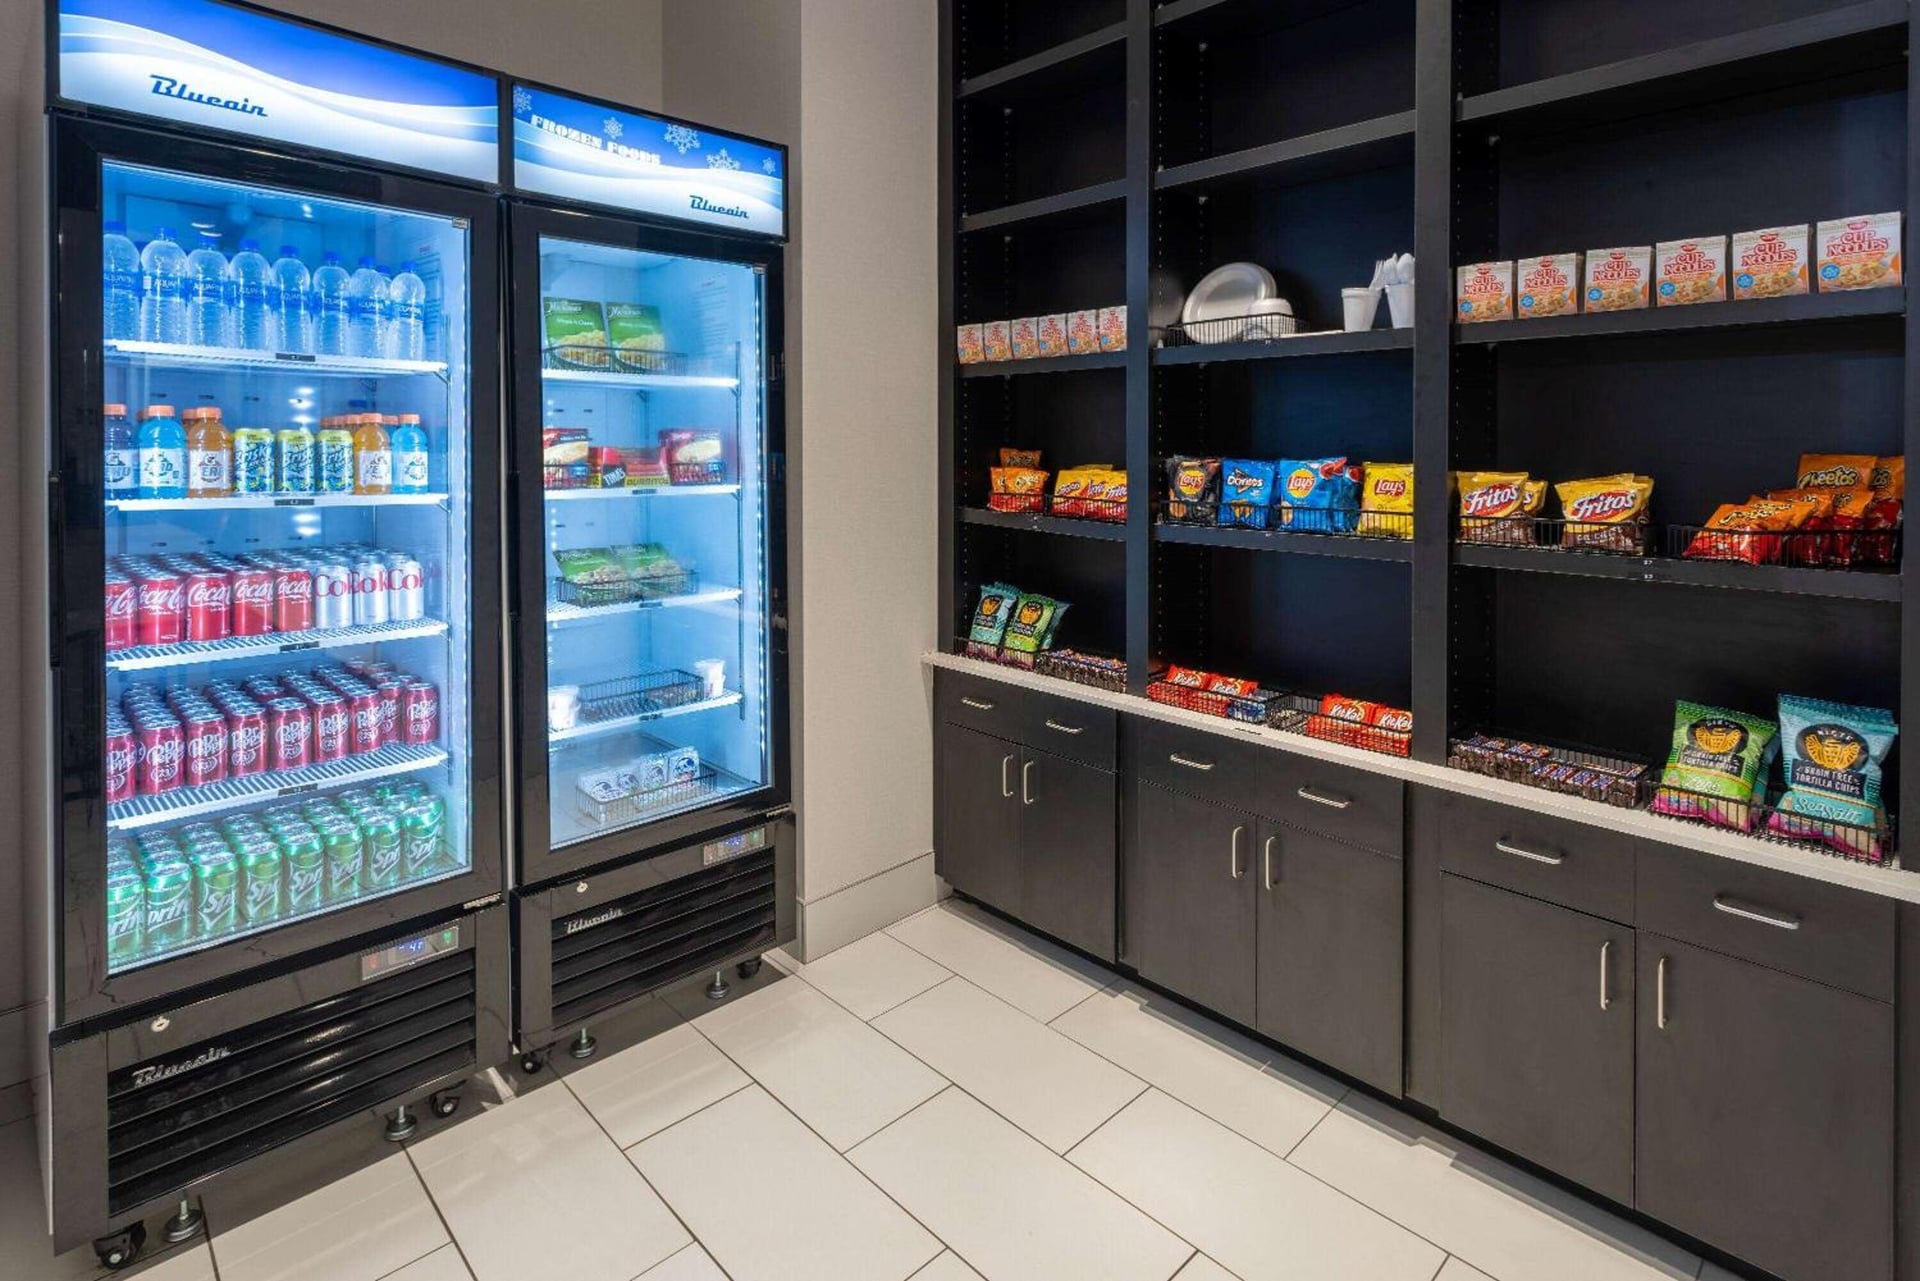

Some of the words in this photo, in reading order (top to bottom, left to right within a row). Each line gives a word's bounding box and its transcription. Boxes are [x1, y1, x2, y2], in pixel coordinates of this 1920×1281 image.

[150, 74, 268, 117] Blueair
[530, 114, 602, 149] FROZEN
[689, 195, 748, 219] Blueair
[1754, 241, 1786, 255] CUP
[1826, 237, 1889, 257] NOODLES
[1841, 230, 1876, 245] CUP
[1741, 250, 1797, 267] NOODLES
[1797, 466, 1859, 489] Cheetos
[1465, 484, 1520, 513] Fritos
[1573, 492, 1636, 518] Fritos
[1795, 772, 1833, 788] TORTILLA
[1834, 782, 1861, 795] CHIPS
